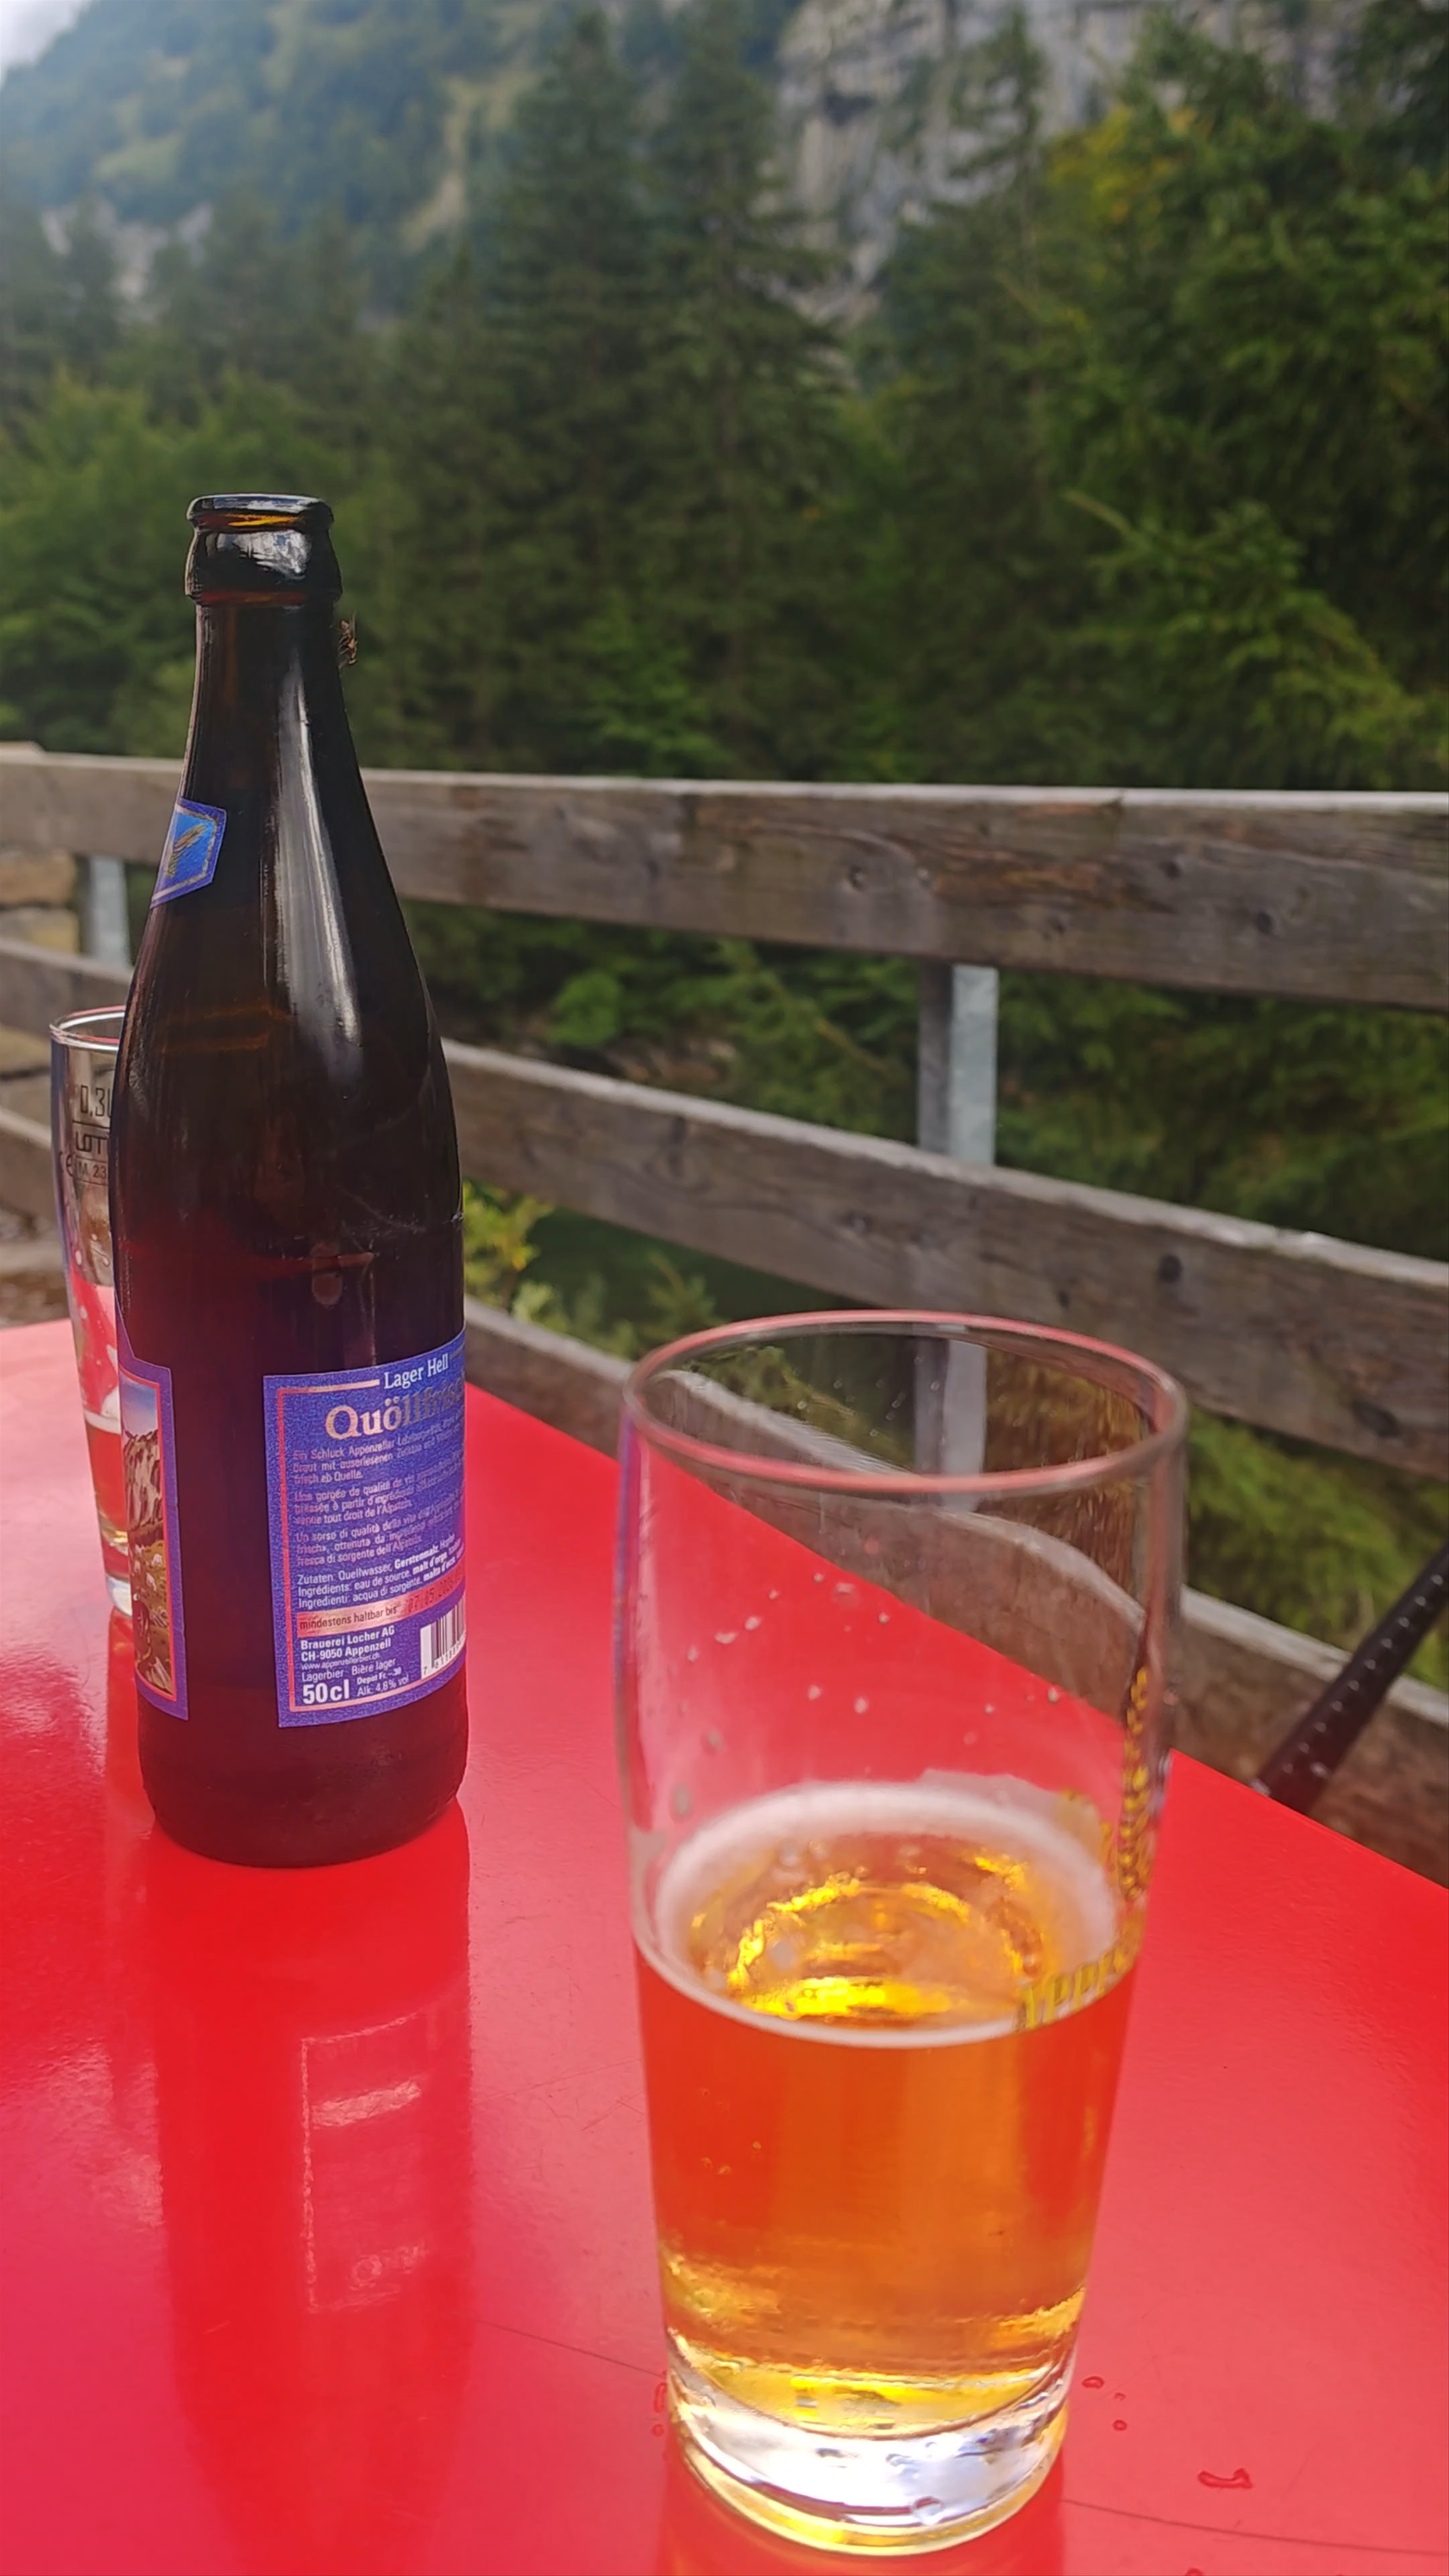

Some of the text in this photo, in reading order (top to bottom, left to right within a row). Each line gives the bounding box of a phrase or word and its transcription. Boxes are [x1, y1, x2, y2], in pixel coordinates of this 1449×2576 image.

[383, 1353, 449, 1389] Lager Hell
[311, 1447, 345, 1460] Schluck
[321, 1460, 336, 1471] mit
[348, 1486, 360, 1497] de
[341, 1498, 365, 1512] partir
[323, 1513, 342, 1524] tout
[343, 1509, 363, 1521] droit
[365, 1507, 375, 1518] de
[340, 1529, 348, 1539] di
[375, 1534, 385, 1544] da
[327, 1554, 335, 1563] di
[337, 1549, 375, 1563] sorgente
[354, 1580, 371, 1590] eau
[372, 1575, 383, 1587] de
[352, 1590, 378, 1602] acqua
[380, 1586, 388, 1596] di
[300, 1615, 351, 1630] mindestens
[353, 1609, 383, 1623] haltbar
[385, 1605, 397, 1616] bis
[300, 1625, 395, 1650] Brauerei Locher AG
[301, 1637, 392, 1662] CH-9050 Appenzell
[301, 1658, 396, 1684] Lagerbier Bière lager
